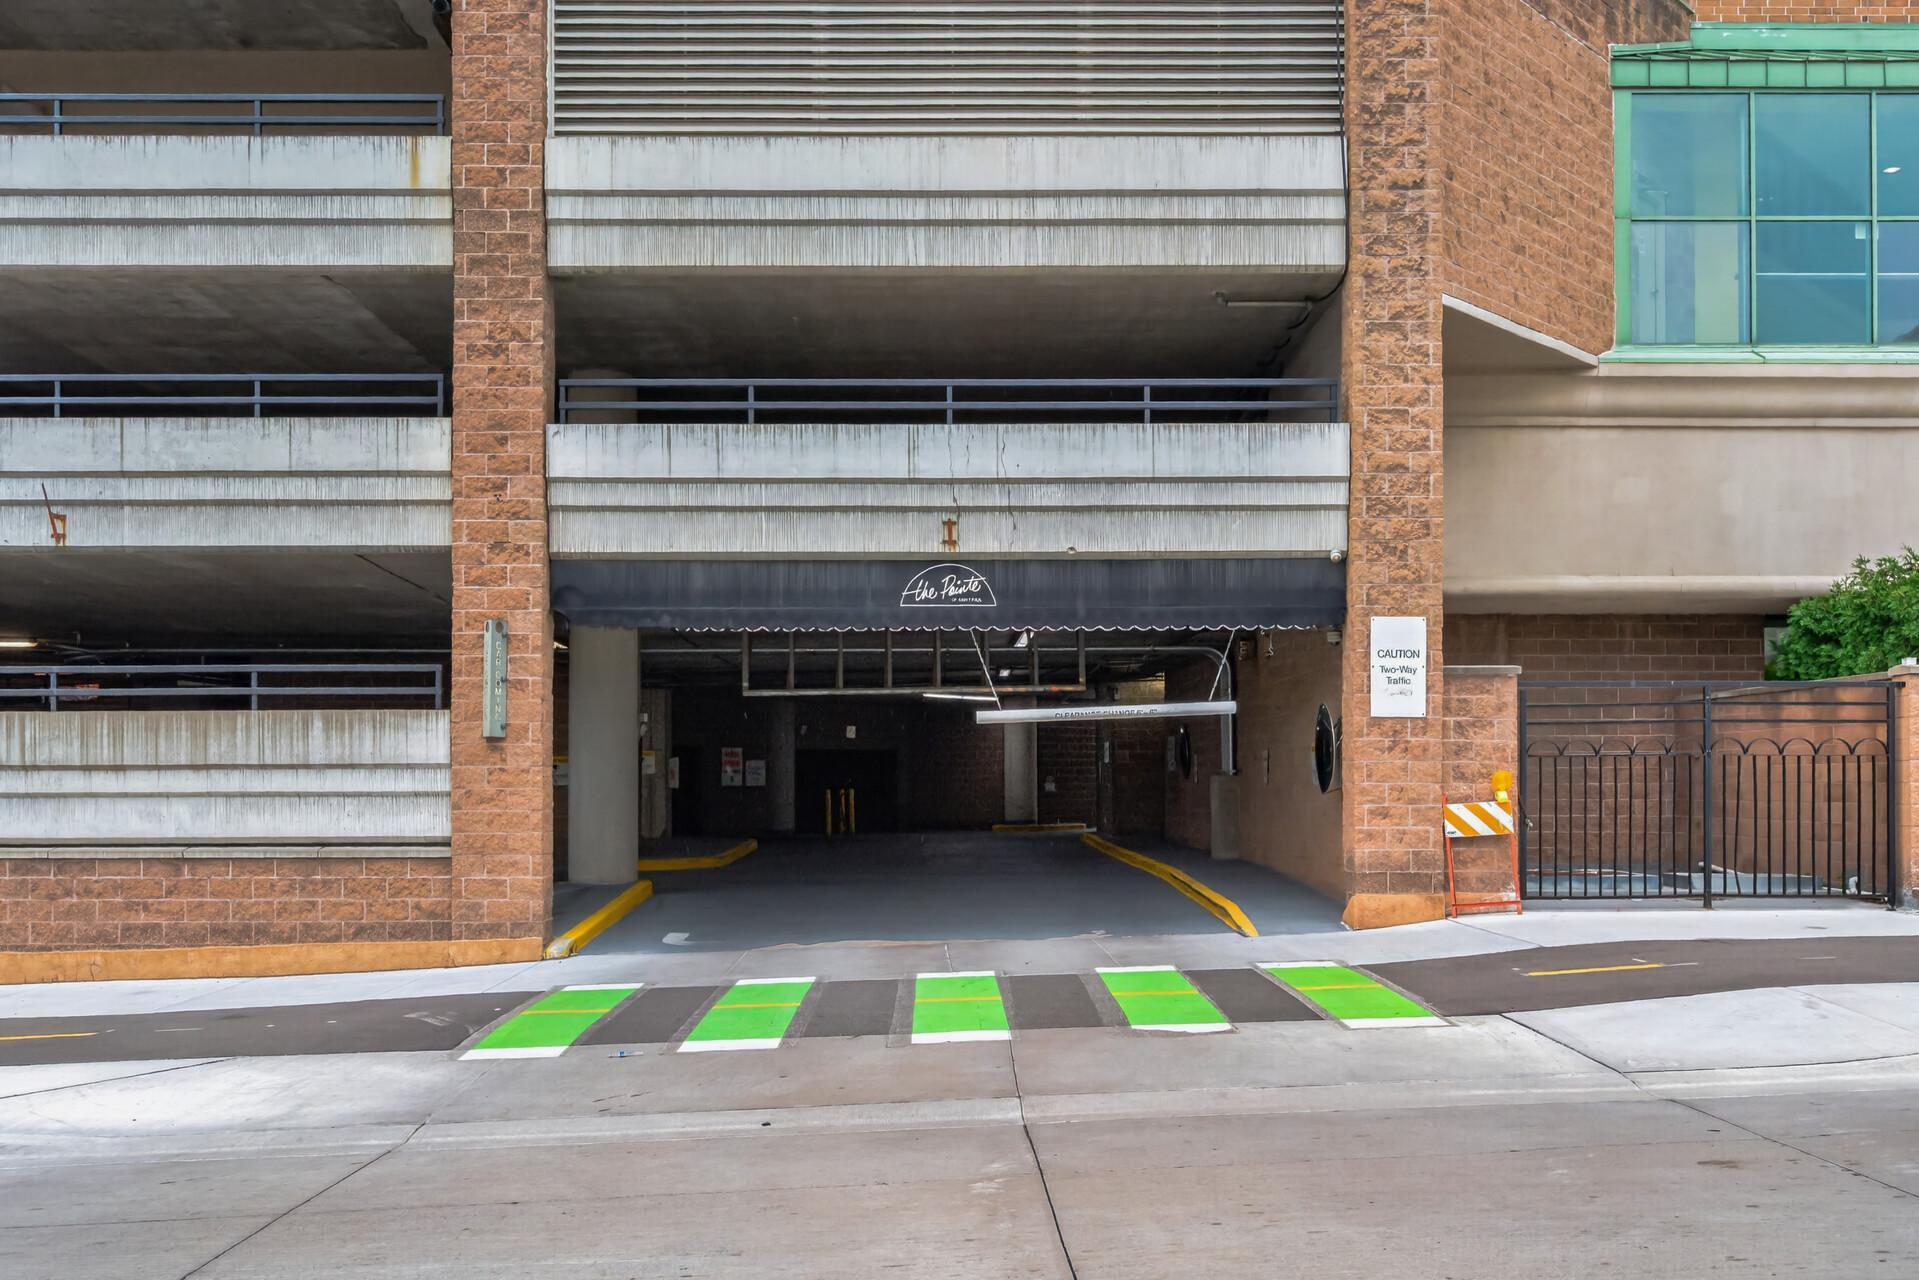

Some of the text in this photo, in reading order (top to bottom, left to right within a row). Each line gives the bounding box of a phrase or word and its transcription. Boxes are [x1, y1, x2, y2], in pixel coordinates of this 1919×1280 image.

[902, 574, 986, 601] the Pointe
[1377, 649, 1420, 658] CAUTION
[1379, 665, 1417, 675] Two-Way
[1385, 676, 1412, 685] Traffic
[1054, 711, 1102, 719] CLEAR
